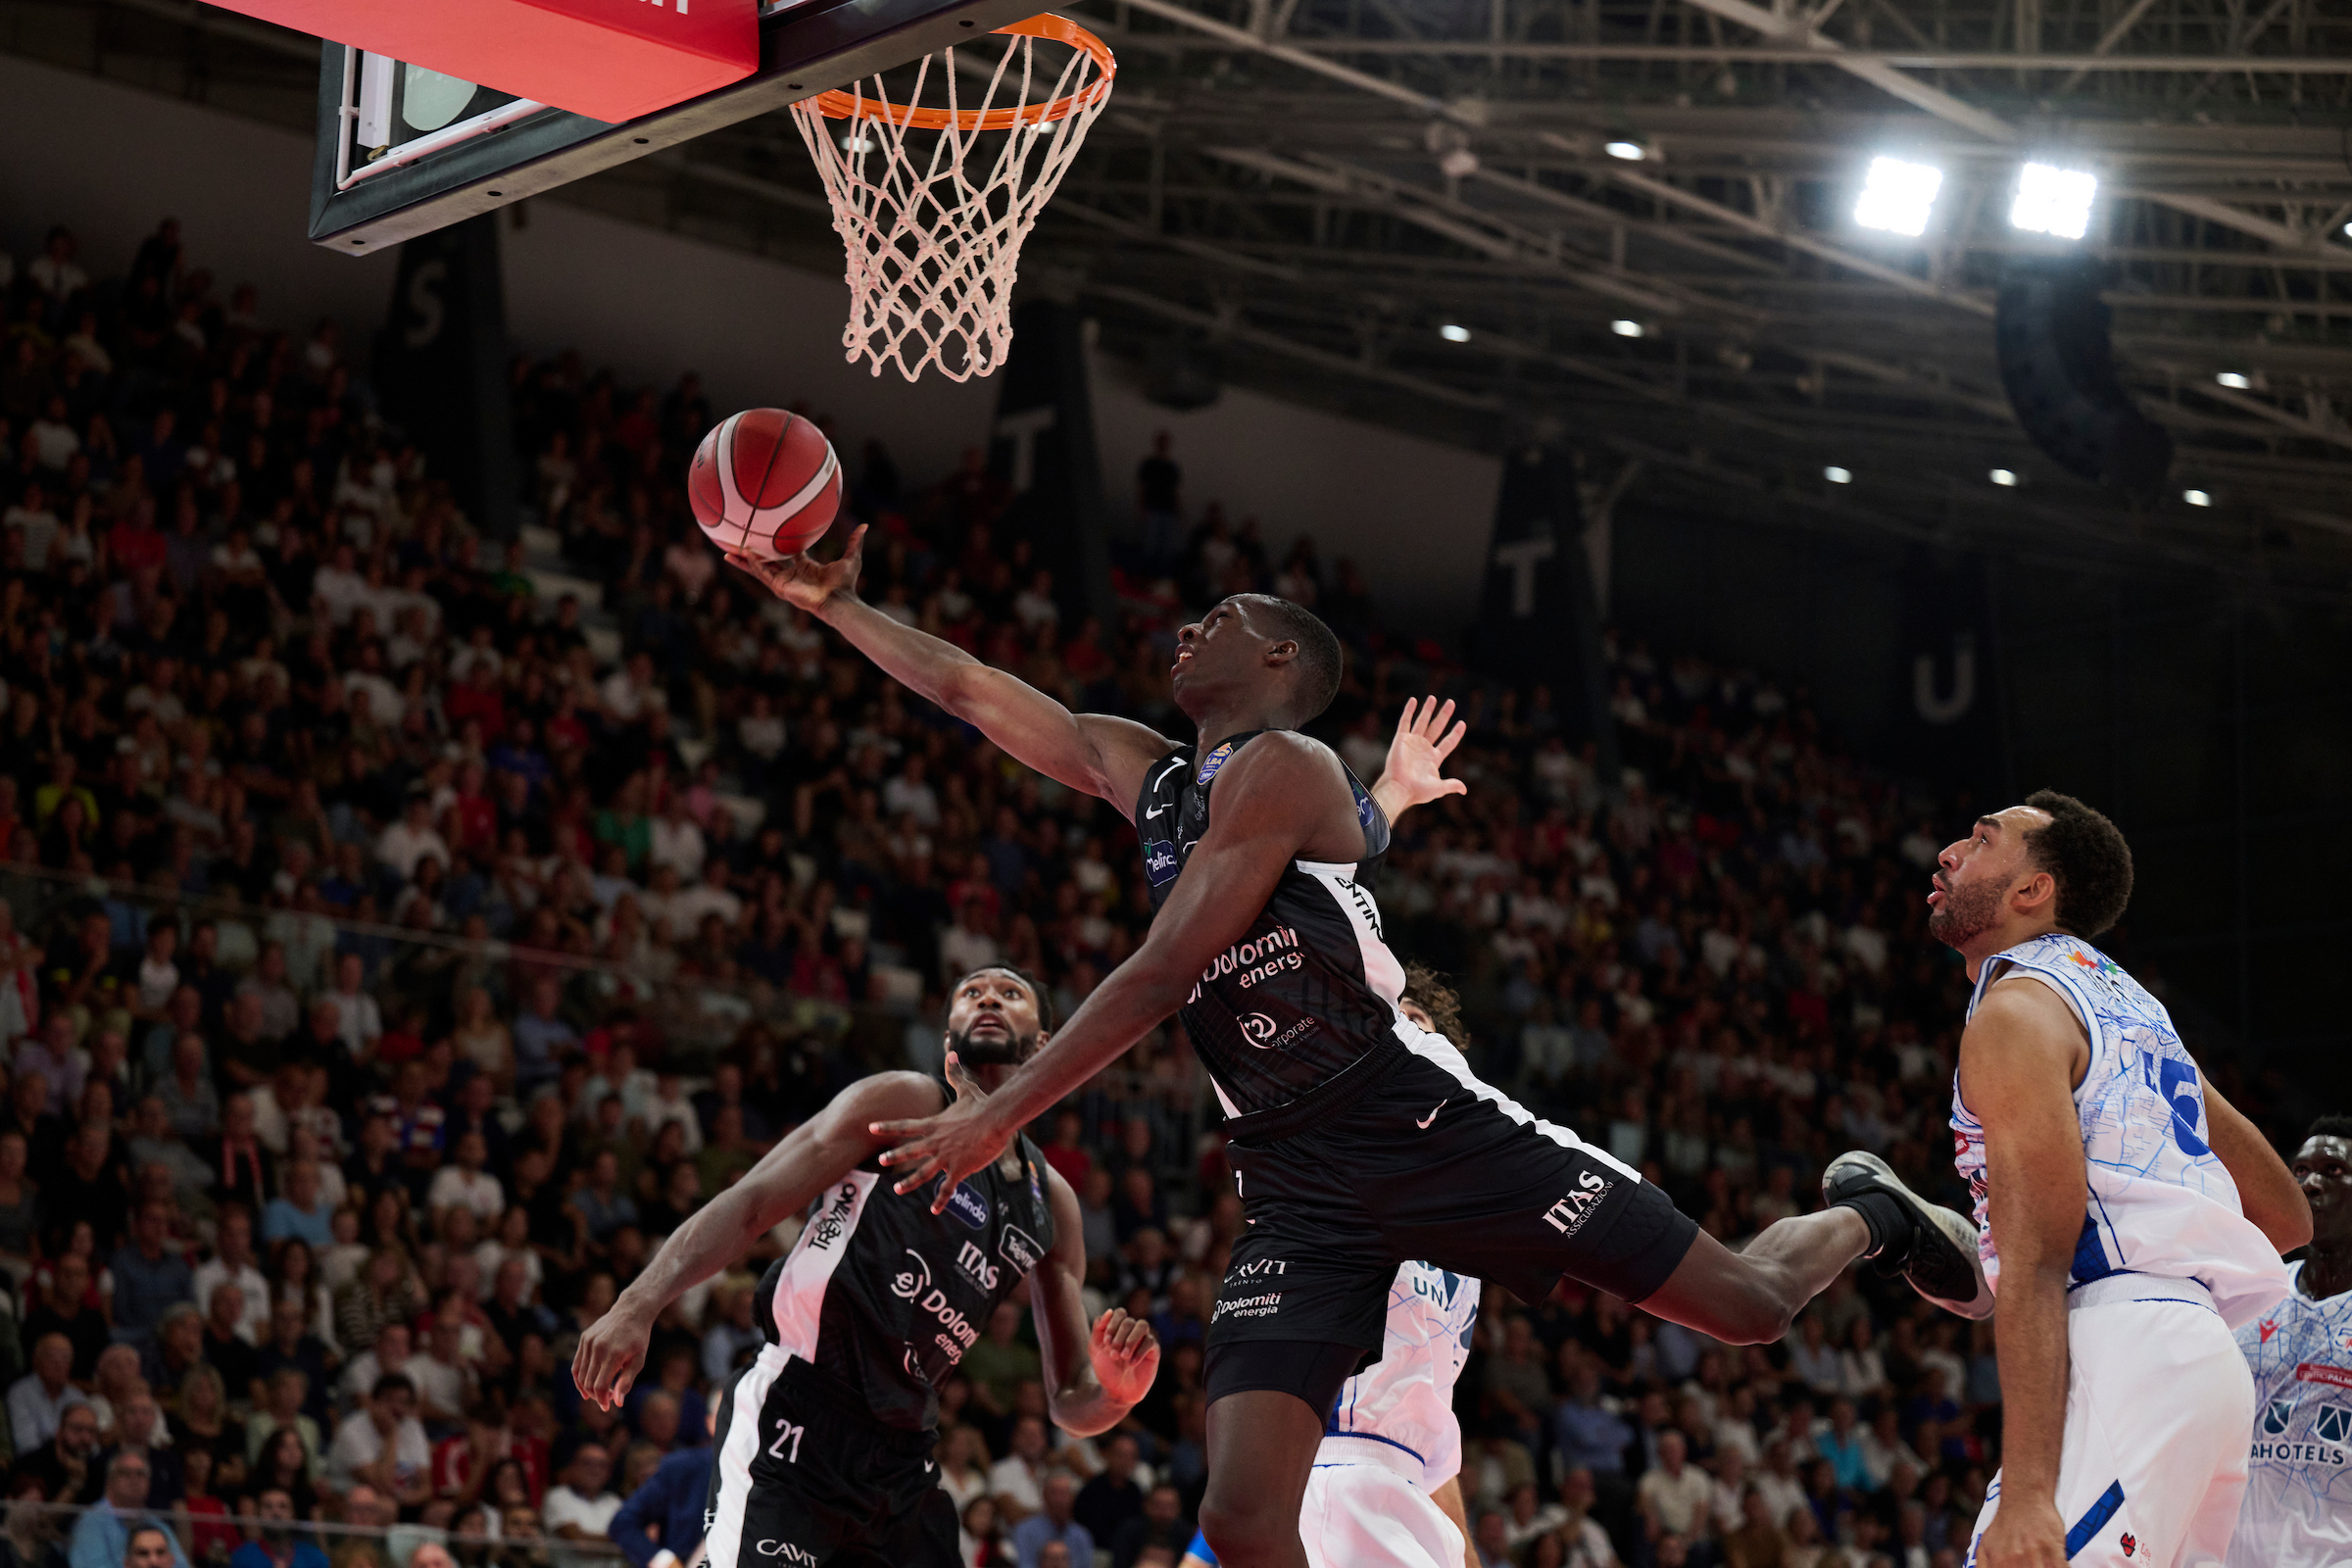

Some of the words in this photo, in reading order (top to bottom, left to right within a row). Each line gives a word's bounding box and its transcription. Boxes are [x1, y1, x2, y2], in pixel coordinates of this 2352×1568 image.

[1205, 757, 1223, 765] LBA
[1239, 951, 1305, 989] energ
[808, 1183, 858, 1250] TRENTINO
[1542, 1169, 1605, 1234] ITAS
[1566, 1181, 1615, 1240] ASSICURAZIONI
[956, 1239, 1000, 1290] ITAS
[1229, 1278, 1263, 1289] TRENTO
[1413, 1276, 1449, 1312] UN
[1220, 1292, 1283, 1315] Dolomiti
[1233, 1305, 1279, 1318] energia
[768, 1418, 805, 1464] 21
[756, 1538, 818, 1568] CAVIT
